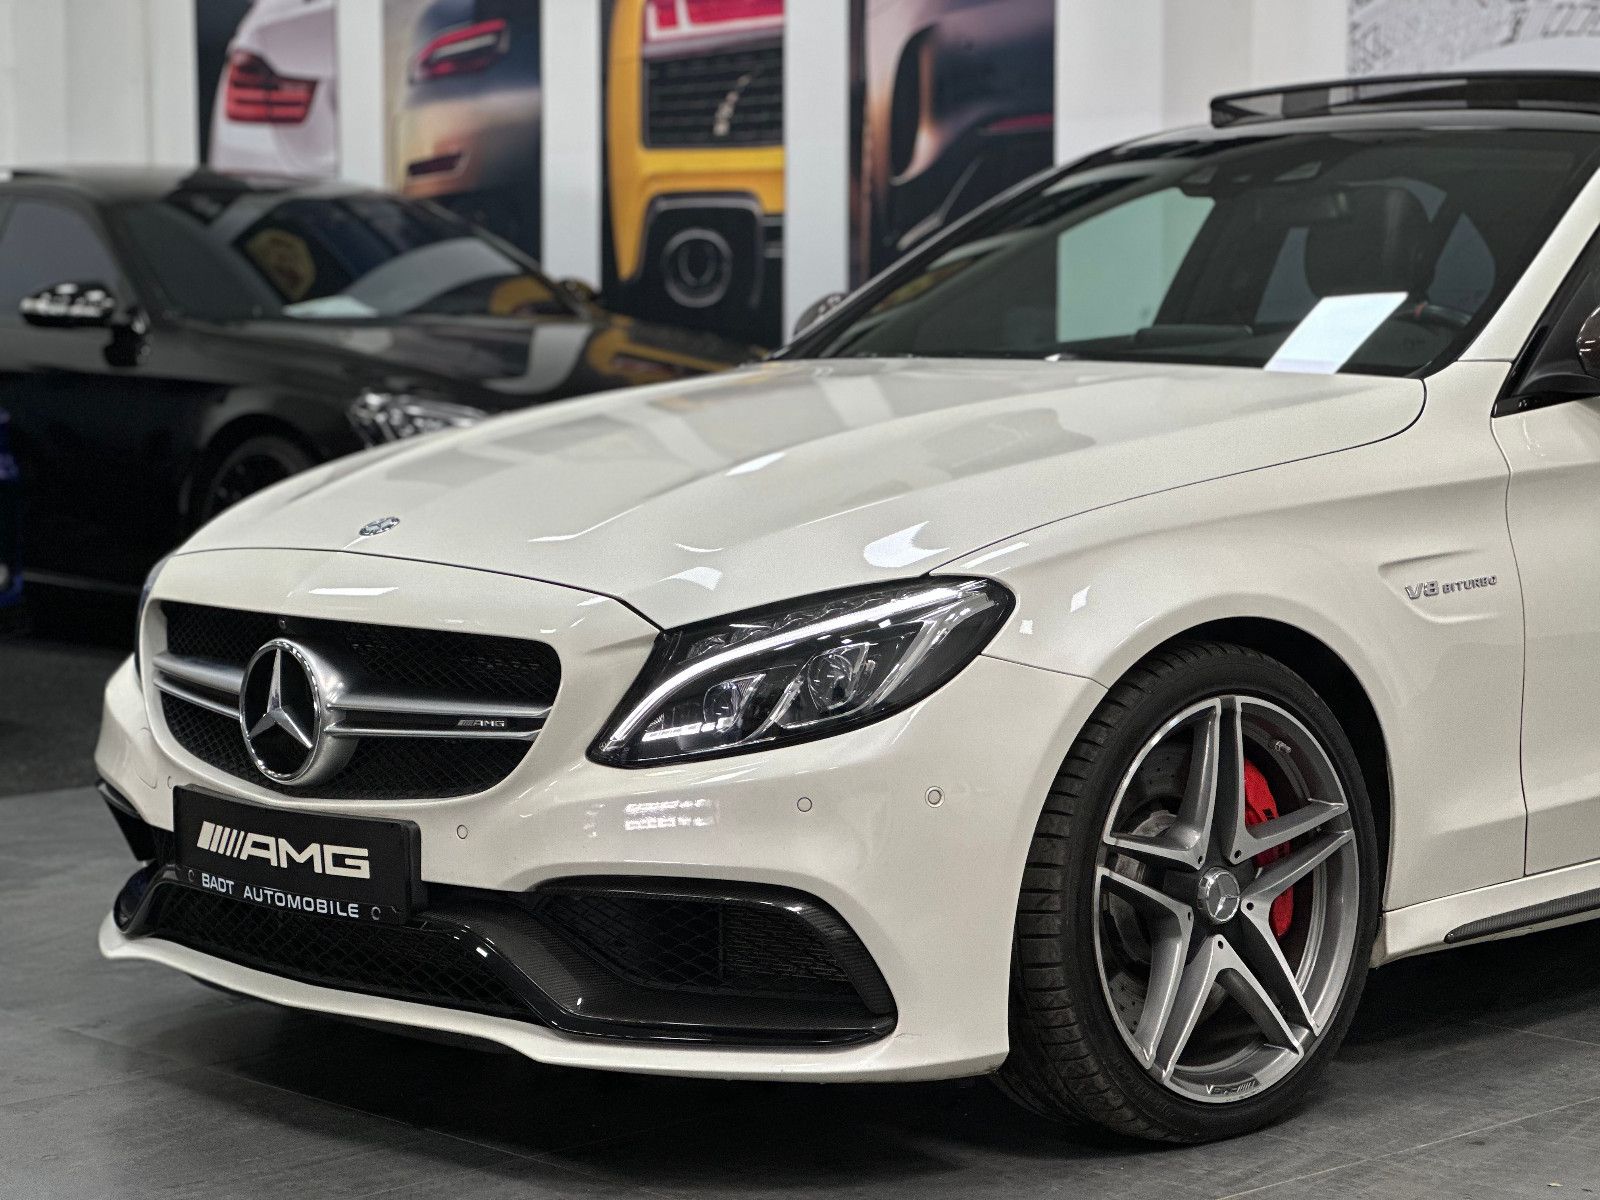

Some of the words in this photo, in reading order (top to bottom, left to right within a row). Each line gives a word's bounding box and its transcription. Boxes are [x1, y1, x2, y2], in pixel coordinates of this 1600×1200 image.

[1405, 581, 1439, 600] V8
[1442, 575, 1498, 594] BITURBO
[240, 832, 370, 879] AMG
[201, 872, 235, 895] BADT
[243, 885, 359, 918] AUTOMOBILE
